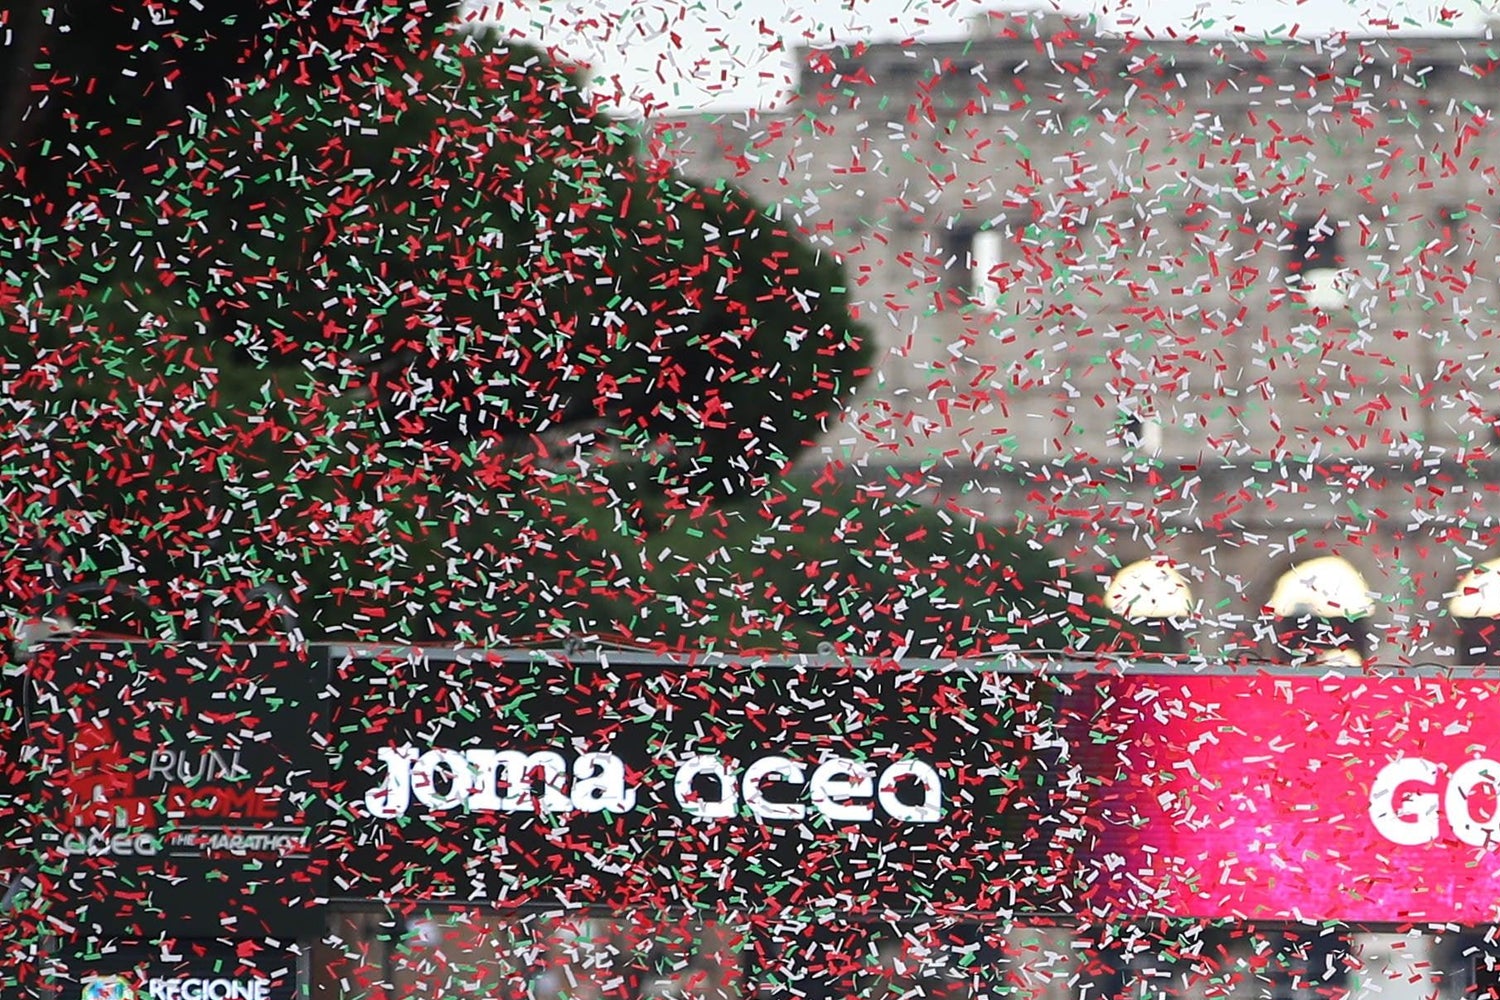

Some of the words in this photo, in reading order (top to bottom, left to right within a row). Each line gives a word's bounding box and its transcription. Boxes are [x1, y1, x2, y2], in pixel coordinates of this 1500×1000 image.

[148, 750, 243, 782] RUN
[364, 746, 635, 819] joma
[673, 754, 943, 823] acea
